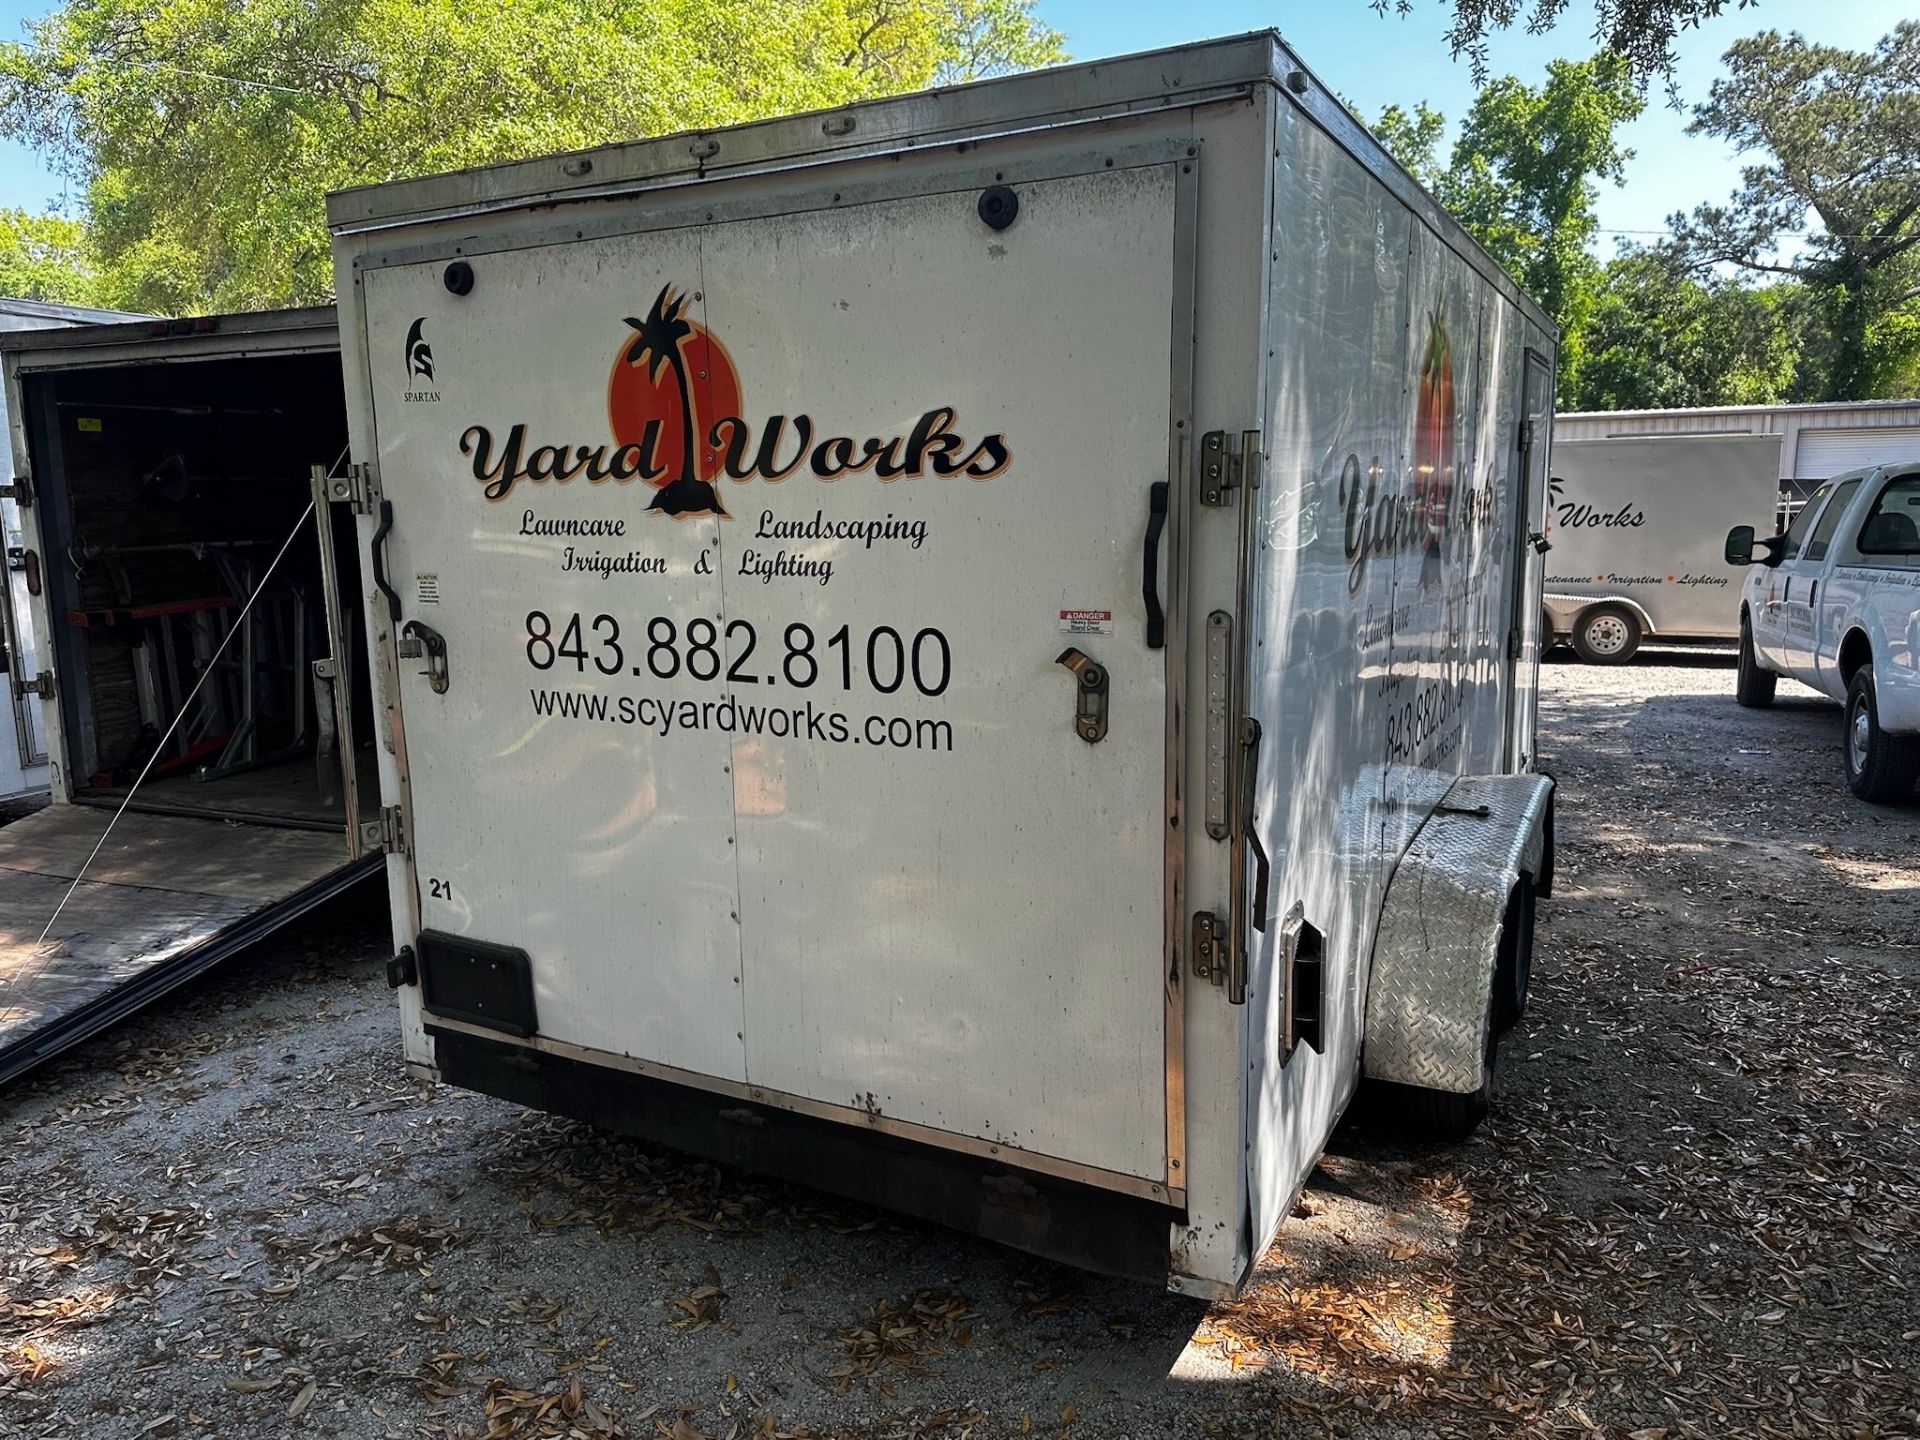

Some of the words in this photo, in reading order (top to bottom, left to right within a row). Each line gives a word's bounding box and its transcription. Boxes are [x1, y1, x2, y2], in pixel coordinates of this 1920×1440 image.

[403, 391, 441, 402] SPARTAN
[459, 418, 670, 501] Yard
[709, 406, 1013, 484] Works
[519, 509, 626, 537] Lawncare
[755, 509, 929, 550] Landscaping
[1557, 502, 1646, 528] Works
[561, 546, 668, 580] Irrigation
[693, 549, 714, 575] &
[738, 549, 835, 586] Lighting
[1606, 573, 1662, 586] Irrigation
[1677, 573, 1728, 586] Lighting
[1072, 612, 1105, 620] DANGER
[525, 610, 952, 697] 843.882.8100
[530, 688, 953, 751] www.scyardworks.com
[429, 878, 452, 901] 21
